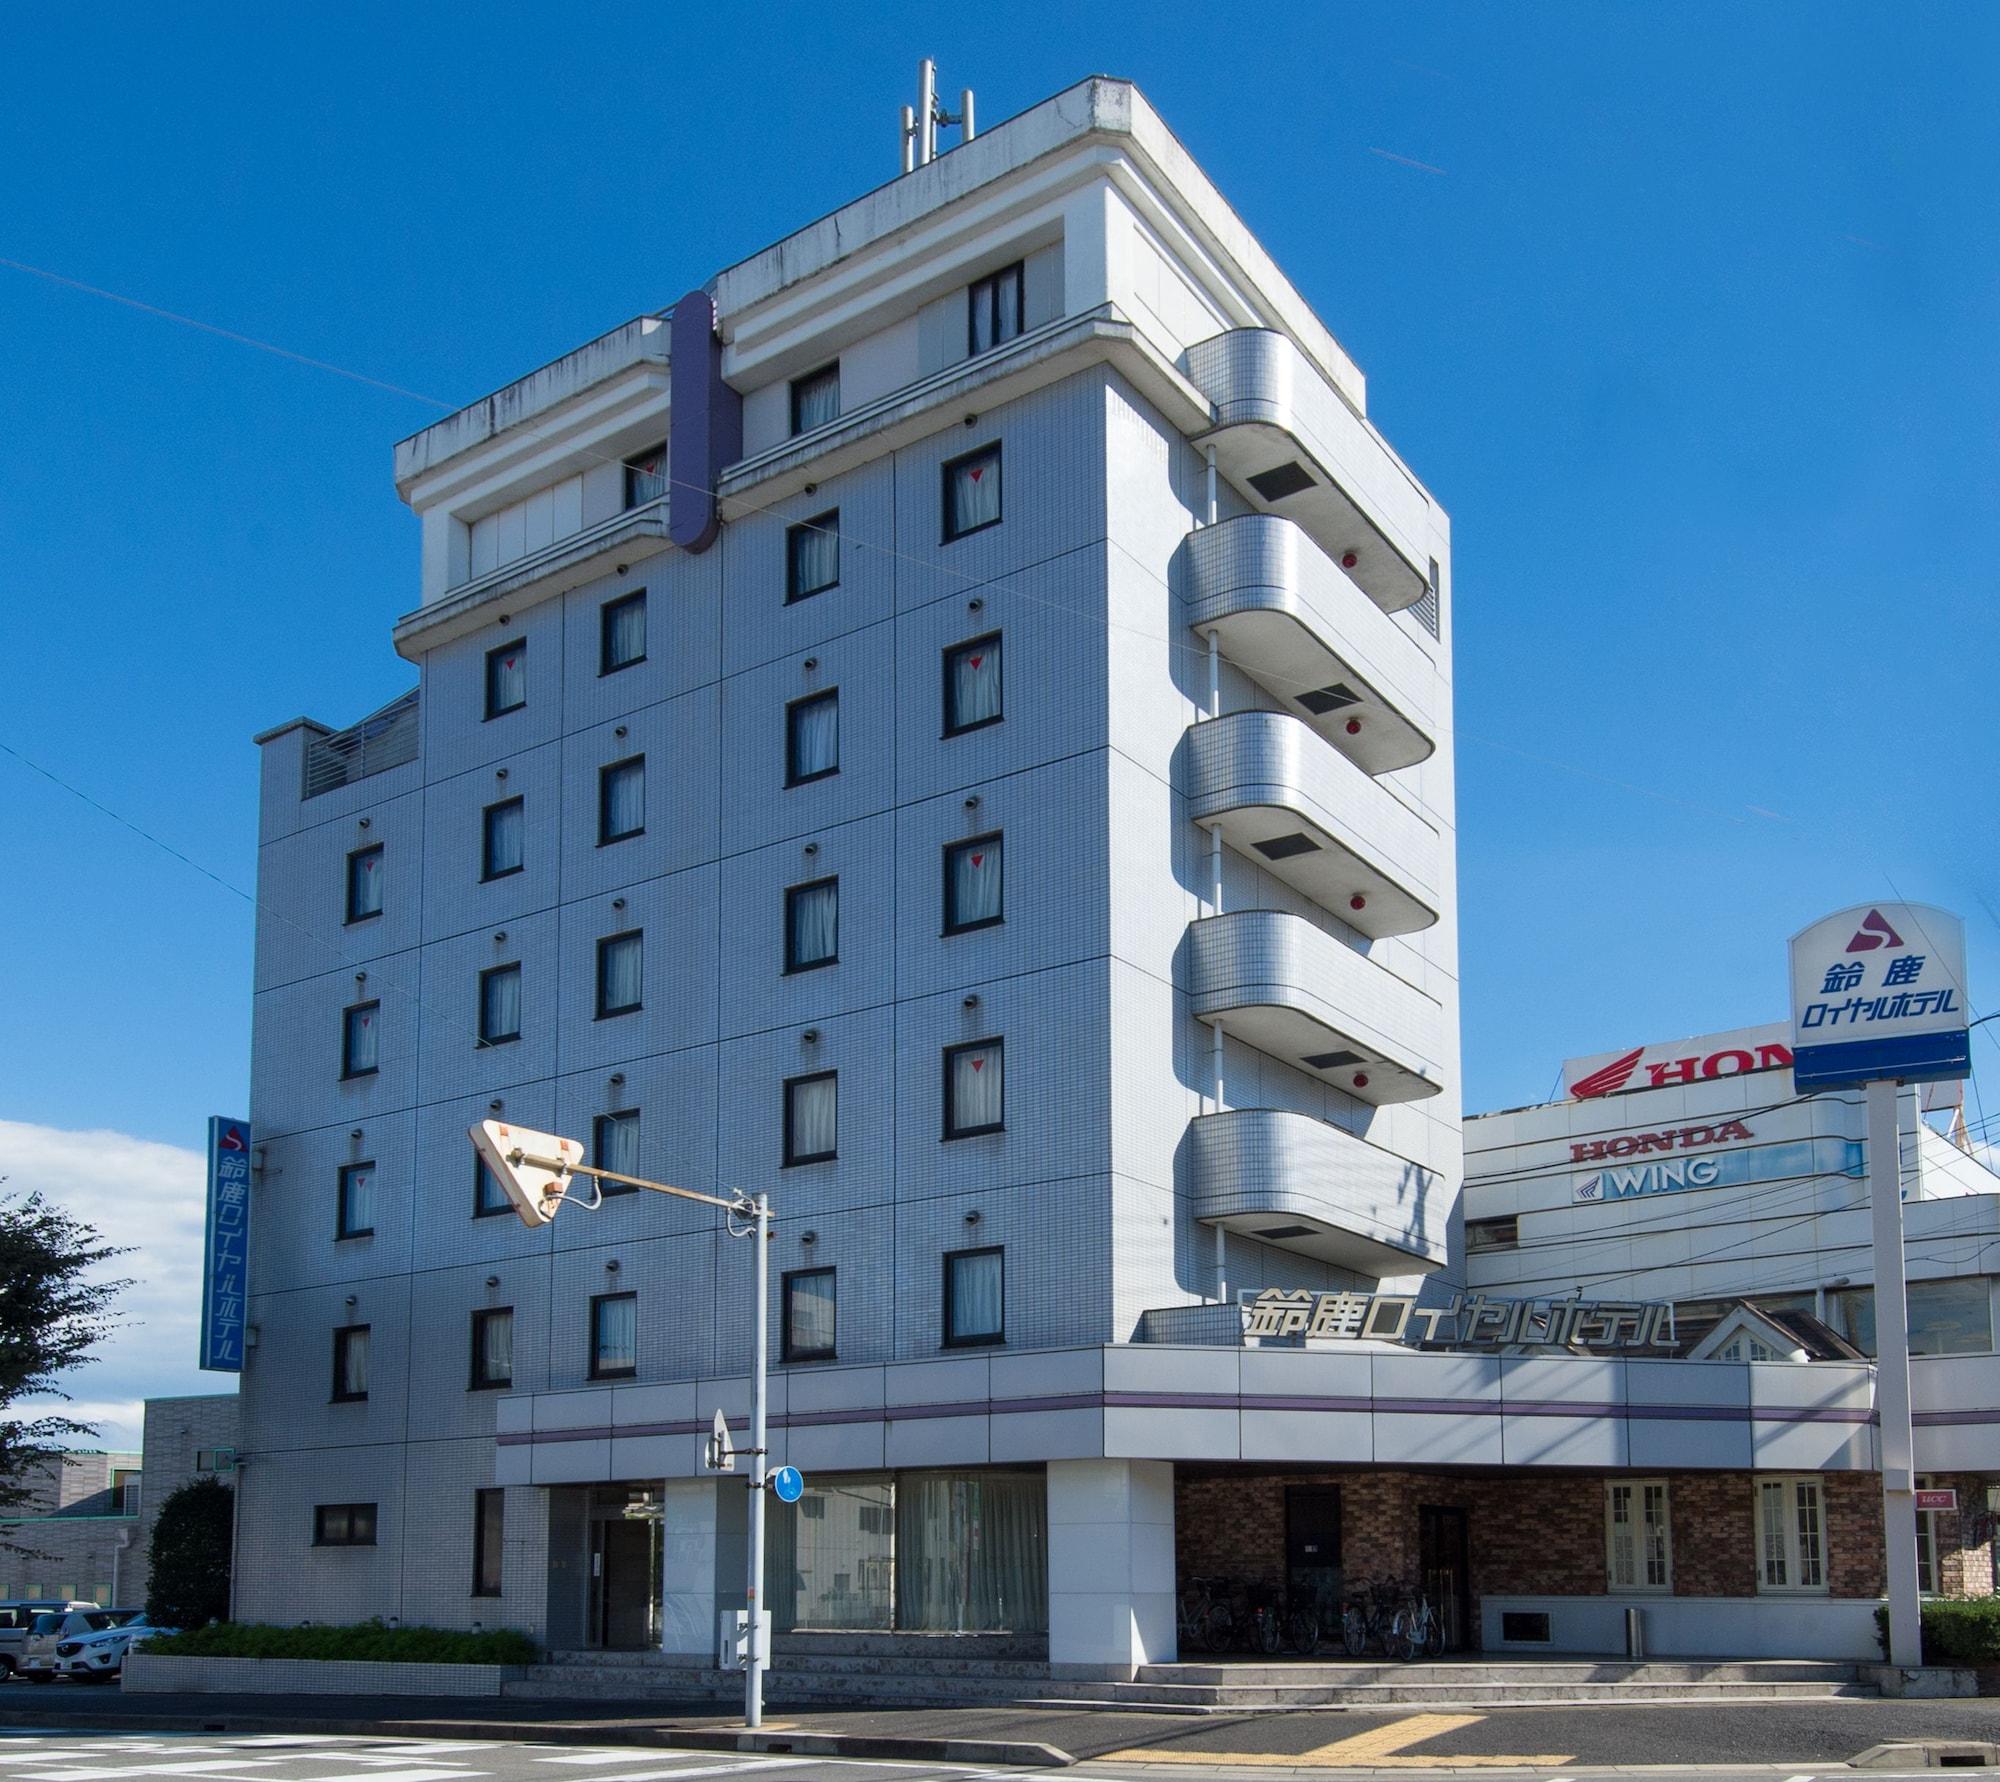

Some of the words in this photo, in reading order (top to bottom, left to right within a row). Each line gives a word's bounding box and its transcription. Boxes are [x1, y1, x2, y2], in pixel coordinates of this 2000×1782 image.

[1801, 988, 1960, 1029] ロイヤルホテル
[1570, 1119, 1754, 1163] HONDA
[1609, 1157, 1720, 1195] WING
[213, 1155, 249, 1362] 鈴鹿ロイヤルホテル
[1243, 1287, 1681, 1347] 鈴鹿ロイヤルホテル
